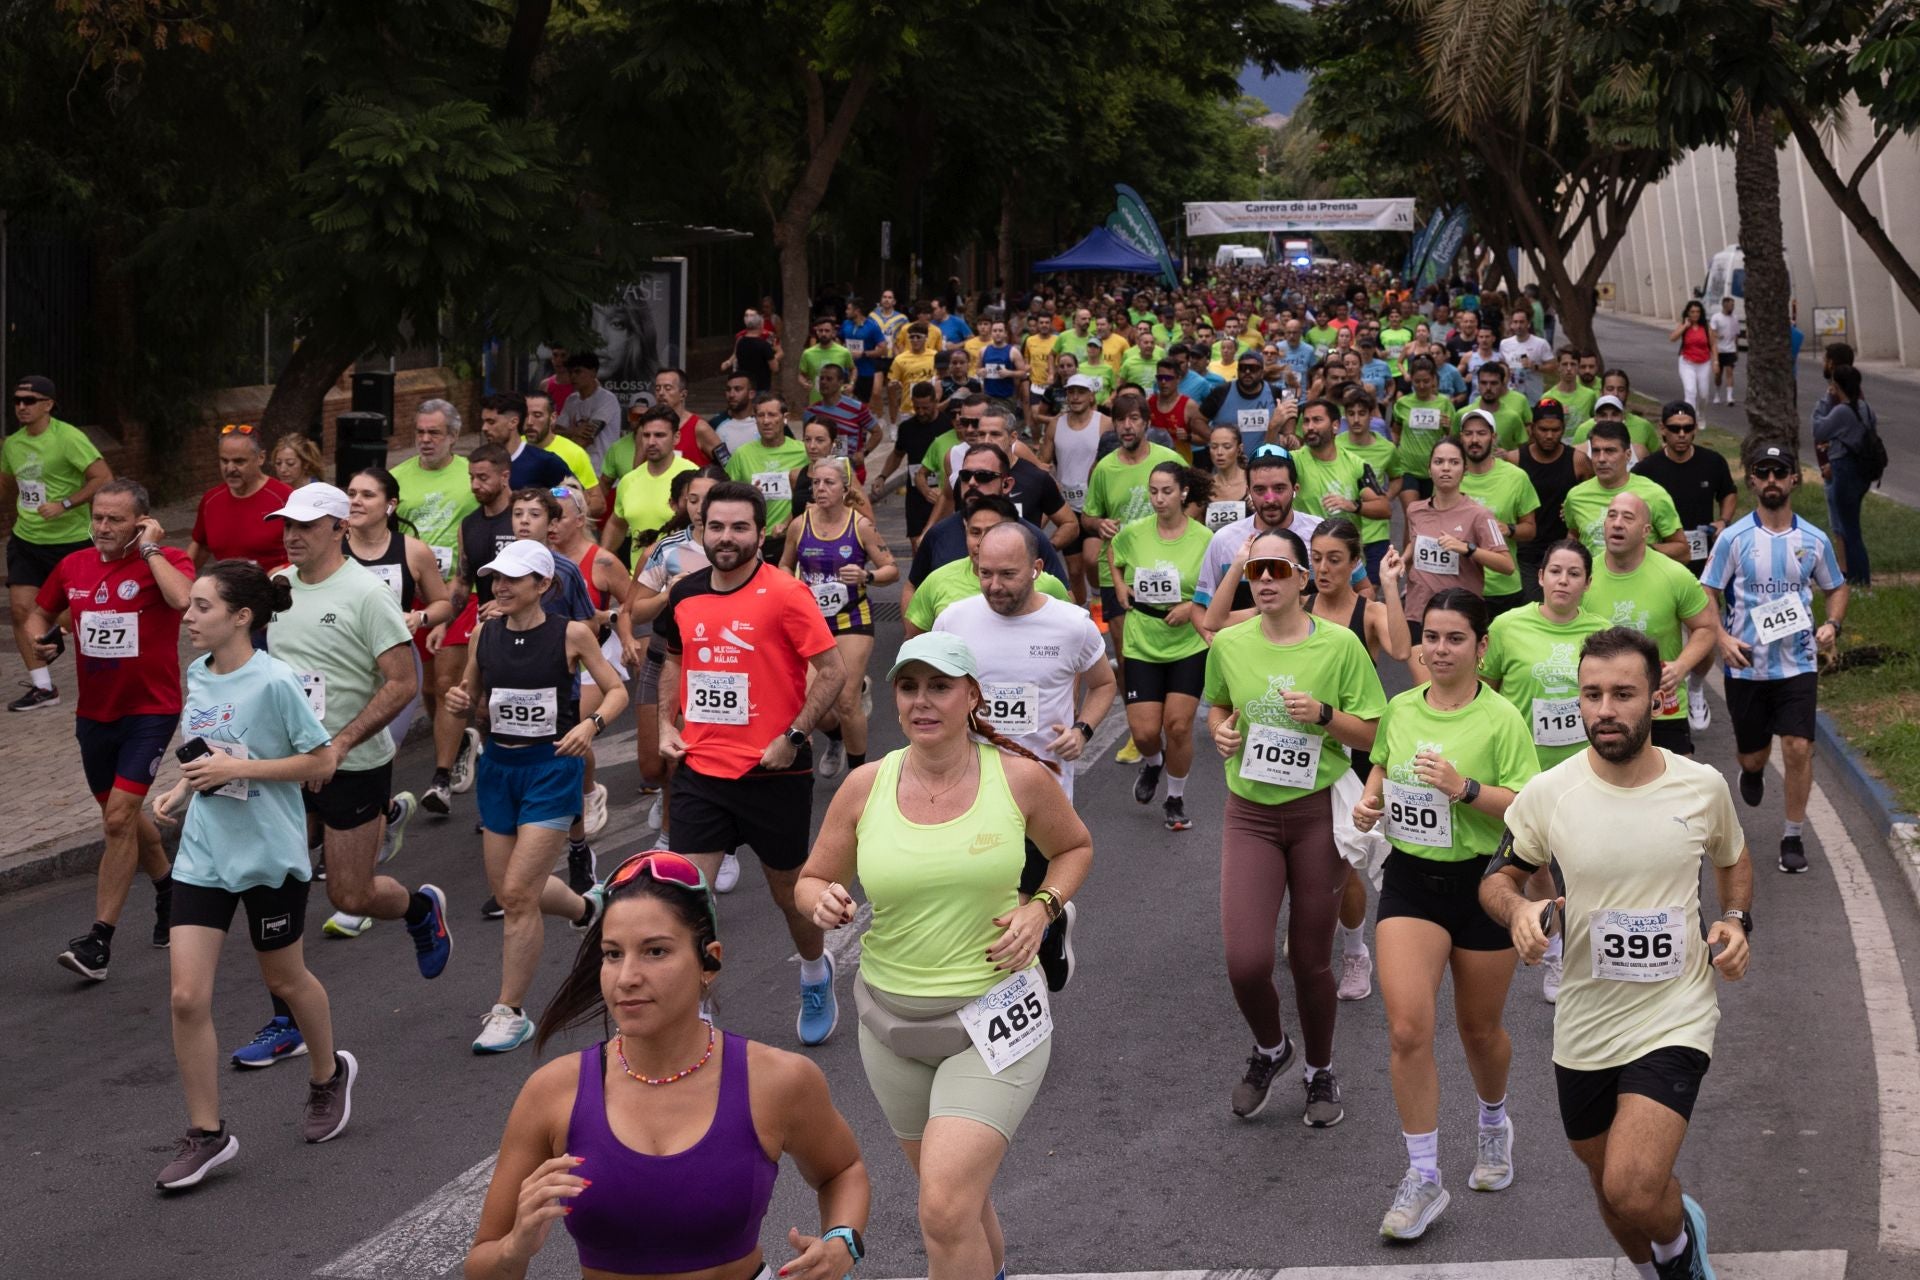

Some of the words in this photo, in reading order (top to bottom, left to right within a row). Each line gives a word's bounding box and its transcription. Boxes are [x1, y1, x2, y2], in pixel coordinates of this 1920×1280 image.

[1245, 203, 1286, 213] Carrera
[1290, 202, 1304, 212] de
[1307, 202, 1317, 211] la
[1320, 201, 1358, 211] Prensa
[604, 380, 652, 391] GLOSSY
[1243, 416, 1264, 425] 719
[1414, 415, 1435, 423] 173
[1211, 511, 1238, 523] 323
[1419, 548, 1451, 564] 916
[1139, 580, 1172, 593] 616
[815, 593, 842, 607] 34
[1762, 607, 1798, 631] 445
[87, 628, 126, 645] 727
[714, 653, 739, 664] MÁLAGA
[695, 689, 738, 709] 358
[499, 704, 546, 722] 592
[1539, 714, 1582, 730] 118
[1252, 743, 1311, 768] 1039
[1391, 802, 1437, 829] 950
[975, 833, 1001, 846] NIKE
[266, 918, 287, 930] PUMA
[1604, 933, 1673, 960] 396
[988, 991, 1043, 1046] 485
